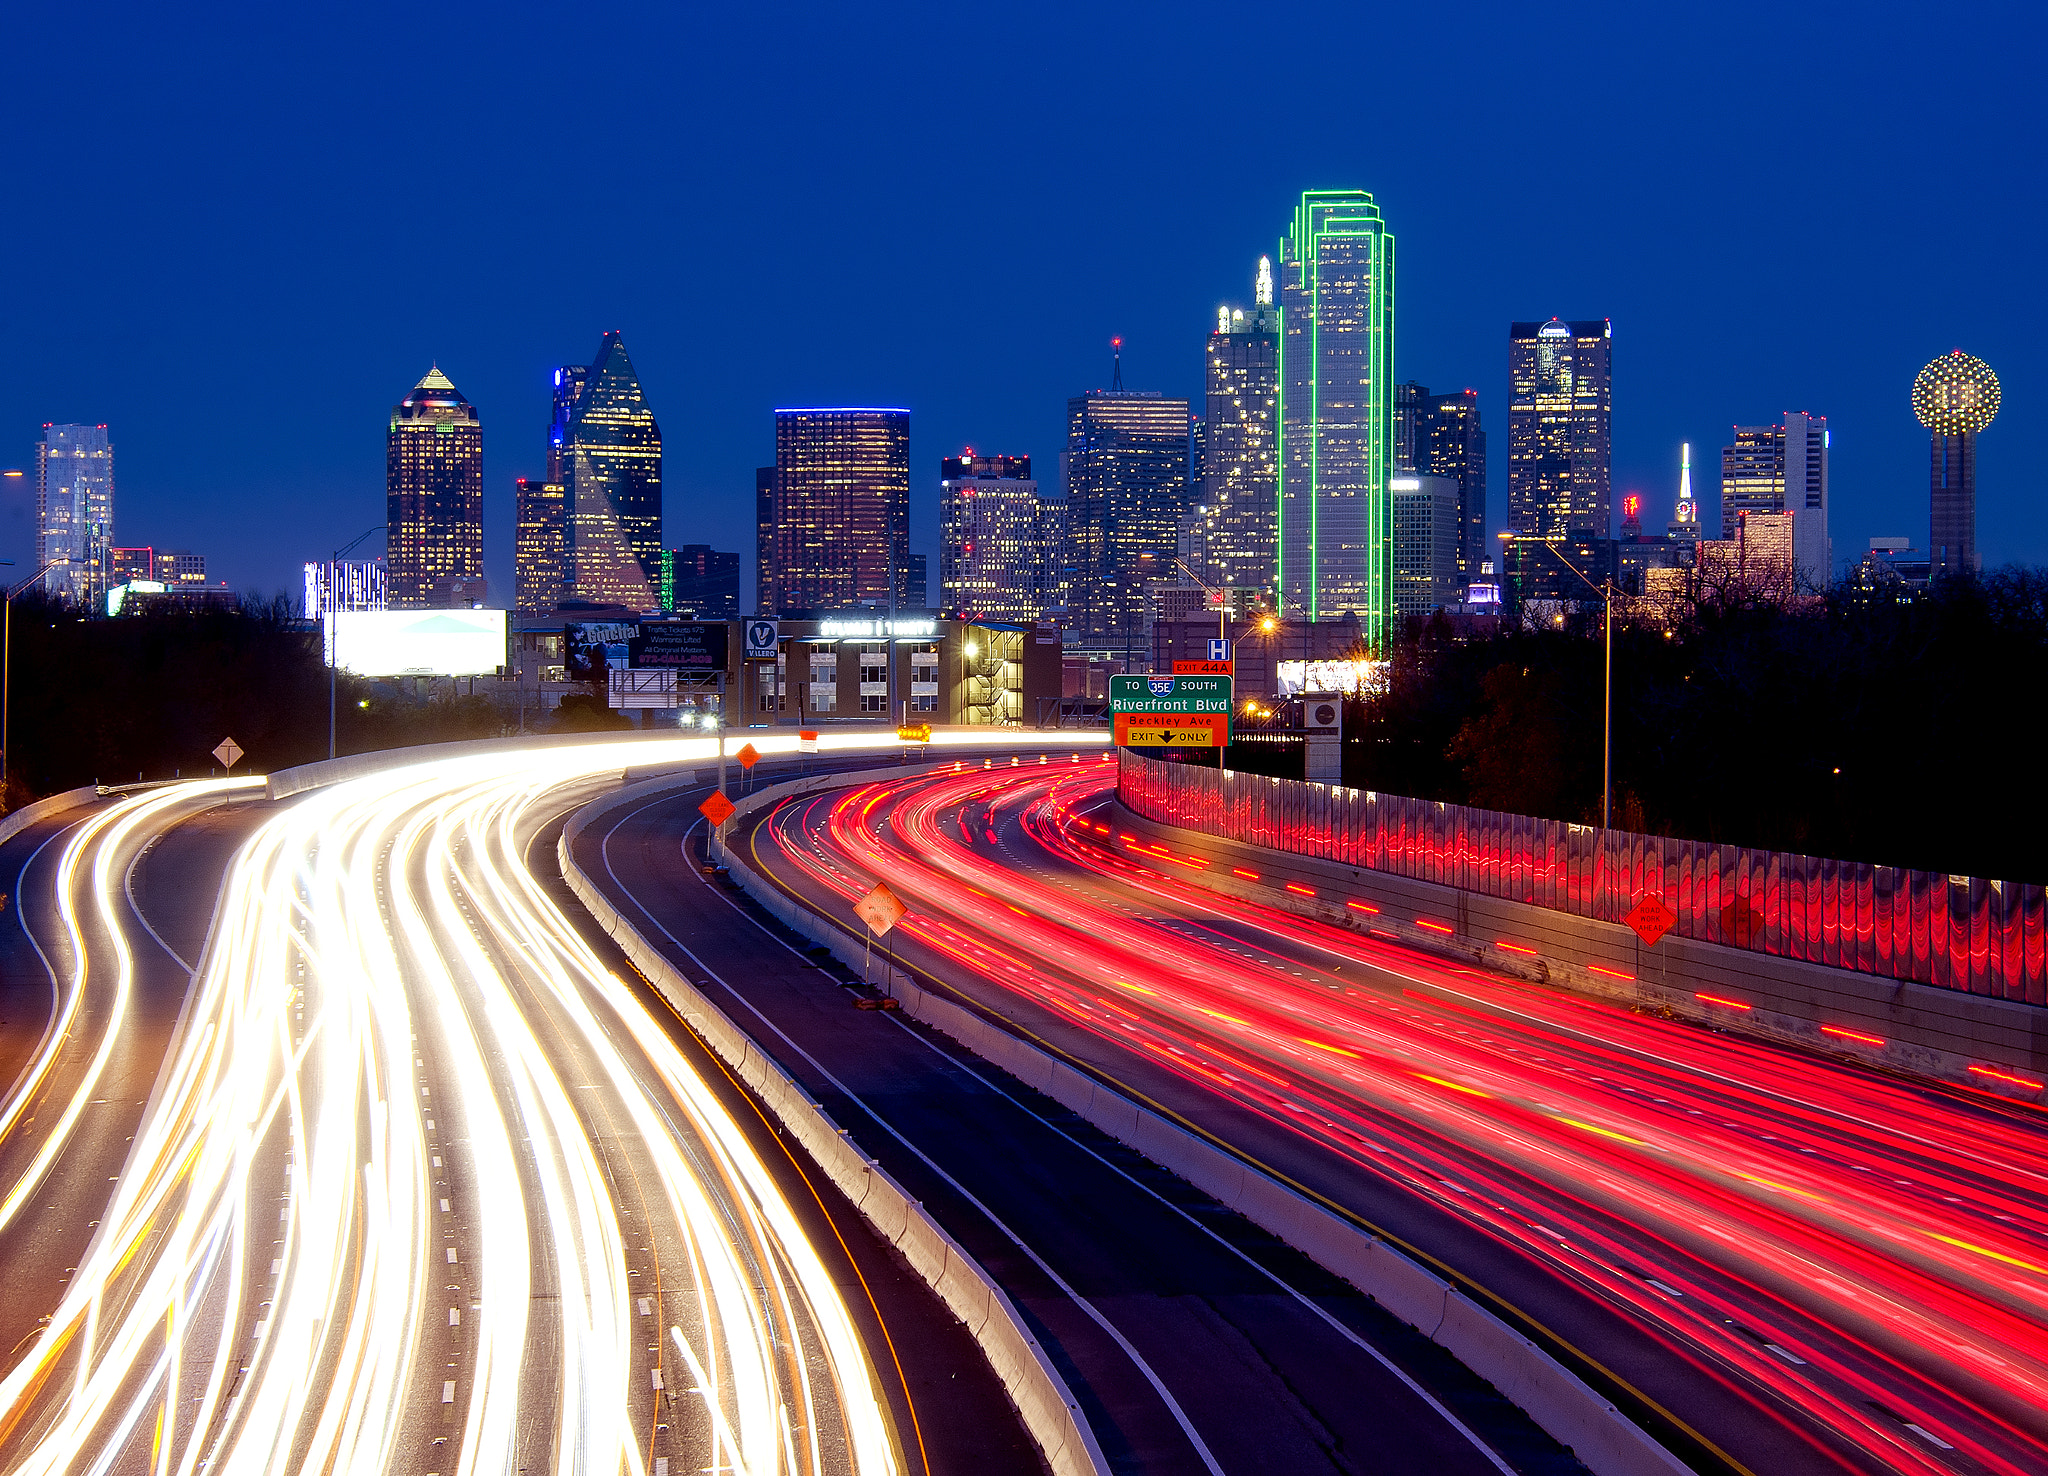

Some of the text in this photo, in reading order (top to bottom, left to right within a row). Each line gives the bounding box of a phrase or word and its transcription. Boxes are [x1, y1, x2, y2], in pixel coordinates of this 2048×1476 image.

[587, 624, 640, 643] Gotcha!
[647, 626, 667, 634] Traffic
[669, 626, 690, 634] Tickets
[650, 636, 701, 644] Warrants Lifted
[653, 646, 680, 654] Criminal
[680, 646, 707, 654] Matters
[1210, 640, 1226, 660] H
[638, 655, 713, 664] 972-CALL-ROB
[1200, 663, 1228, 672] 44A
[1125, 681, 1217, 693] TO 35E SOUTH
[1113, 699, 1227, 711] Riverfront Blvd
[1129, 716, 1212, 727] Beckley Ave
[1131, 732, 1208, 741] EXIT ONLY
[871, 896, 892, 904] ROAD
[869, 914, 894, 922] AHEAD
